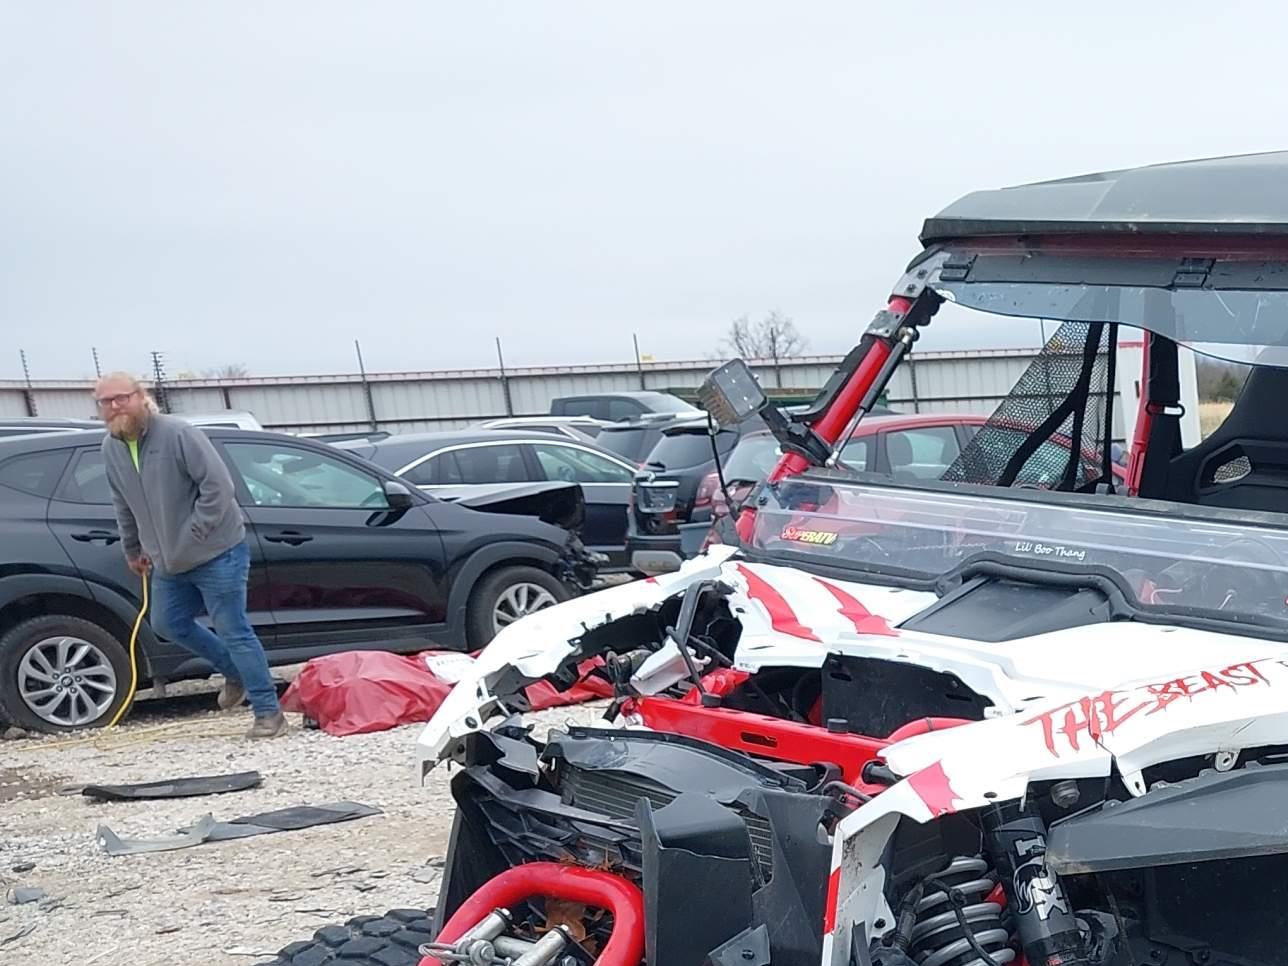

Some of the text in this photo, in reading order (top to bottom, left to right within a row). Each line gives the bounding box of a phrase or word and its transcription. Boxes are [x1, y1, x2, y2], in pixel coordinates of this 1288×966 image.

[1034, 543, 1054, 555] Boo
[1055, 546, 1086, 561] Thang
[1136, 658, 1273, 717] BEAST
